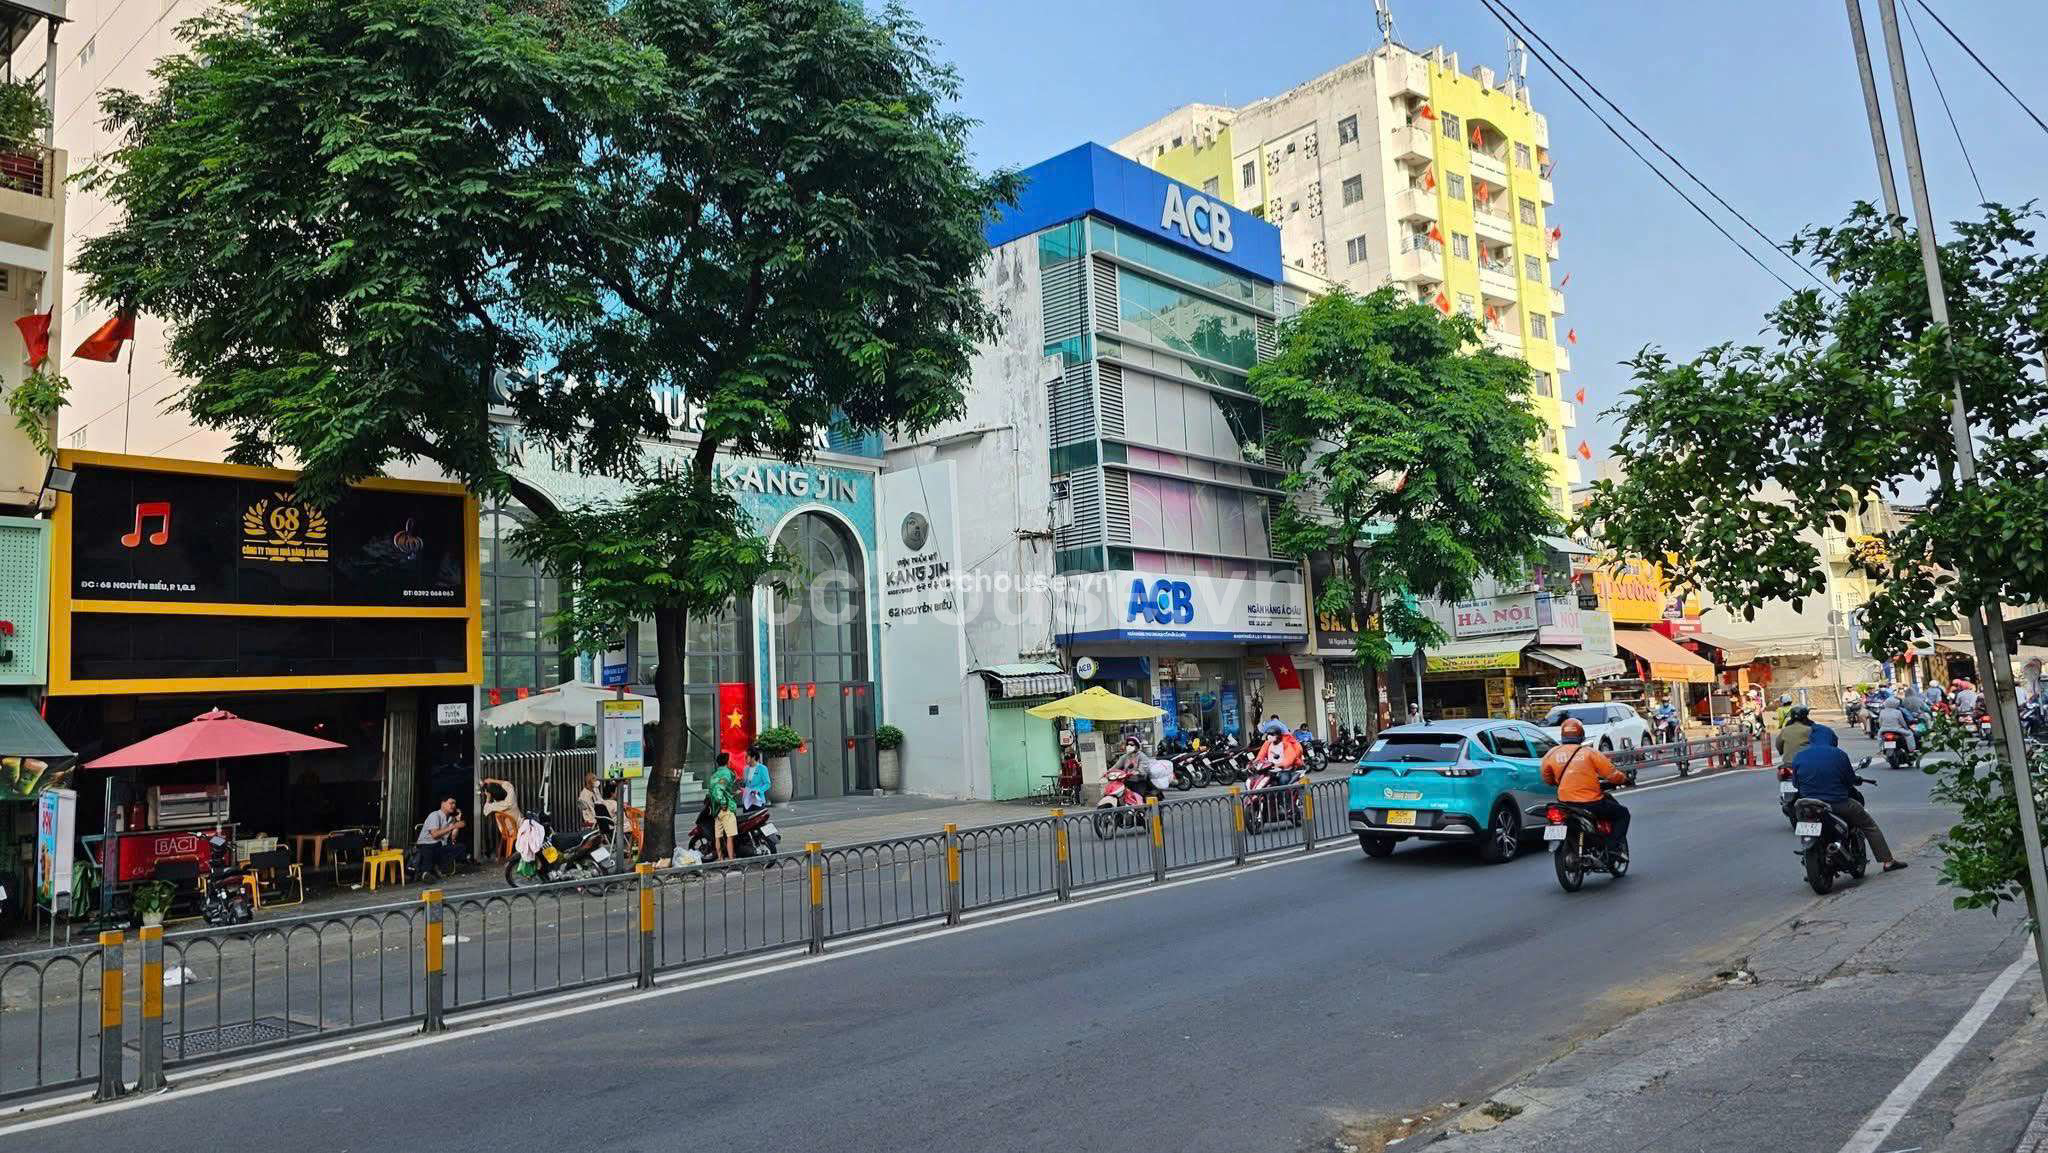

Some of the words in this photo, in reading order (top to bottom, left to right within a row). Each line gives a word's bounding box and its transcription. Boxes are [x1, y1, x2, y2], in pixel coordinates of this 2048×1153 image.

[1161, 184, 1233, 253] ACB
[815, 472, 858, 504] JIN
[270, 506, 300, 531] 68
[100, 581, 112, 589] 68
[886, 565, 926, 587] KANG
[928, 561, 949, 580] JIN
[888, 607, 901, 618] 62
[1127, 578, 1195, 625] ACB
[1457, 608, 1488, 627] HÀ
[1493, 604, 1532, 624] NỘI
[1079, 662, 1092, 673] ACB
[160, 837, 193, 852] BACI
